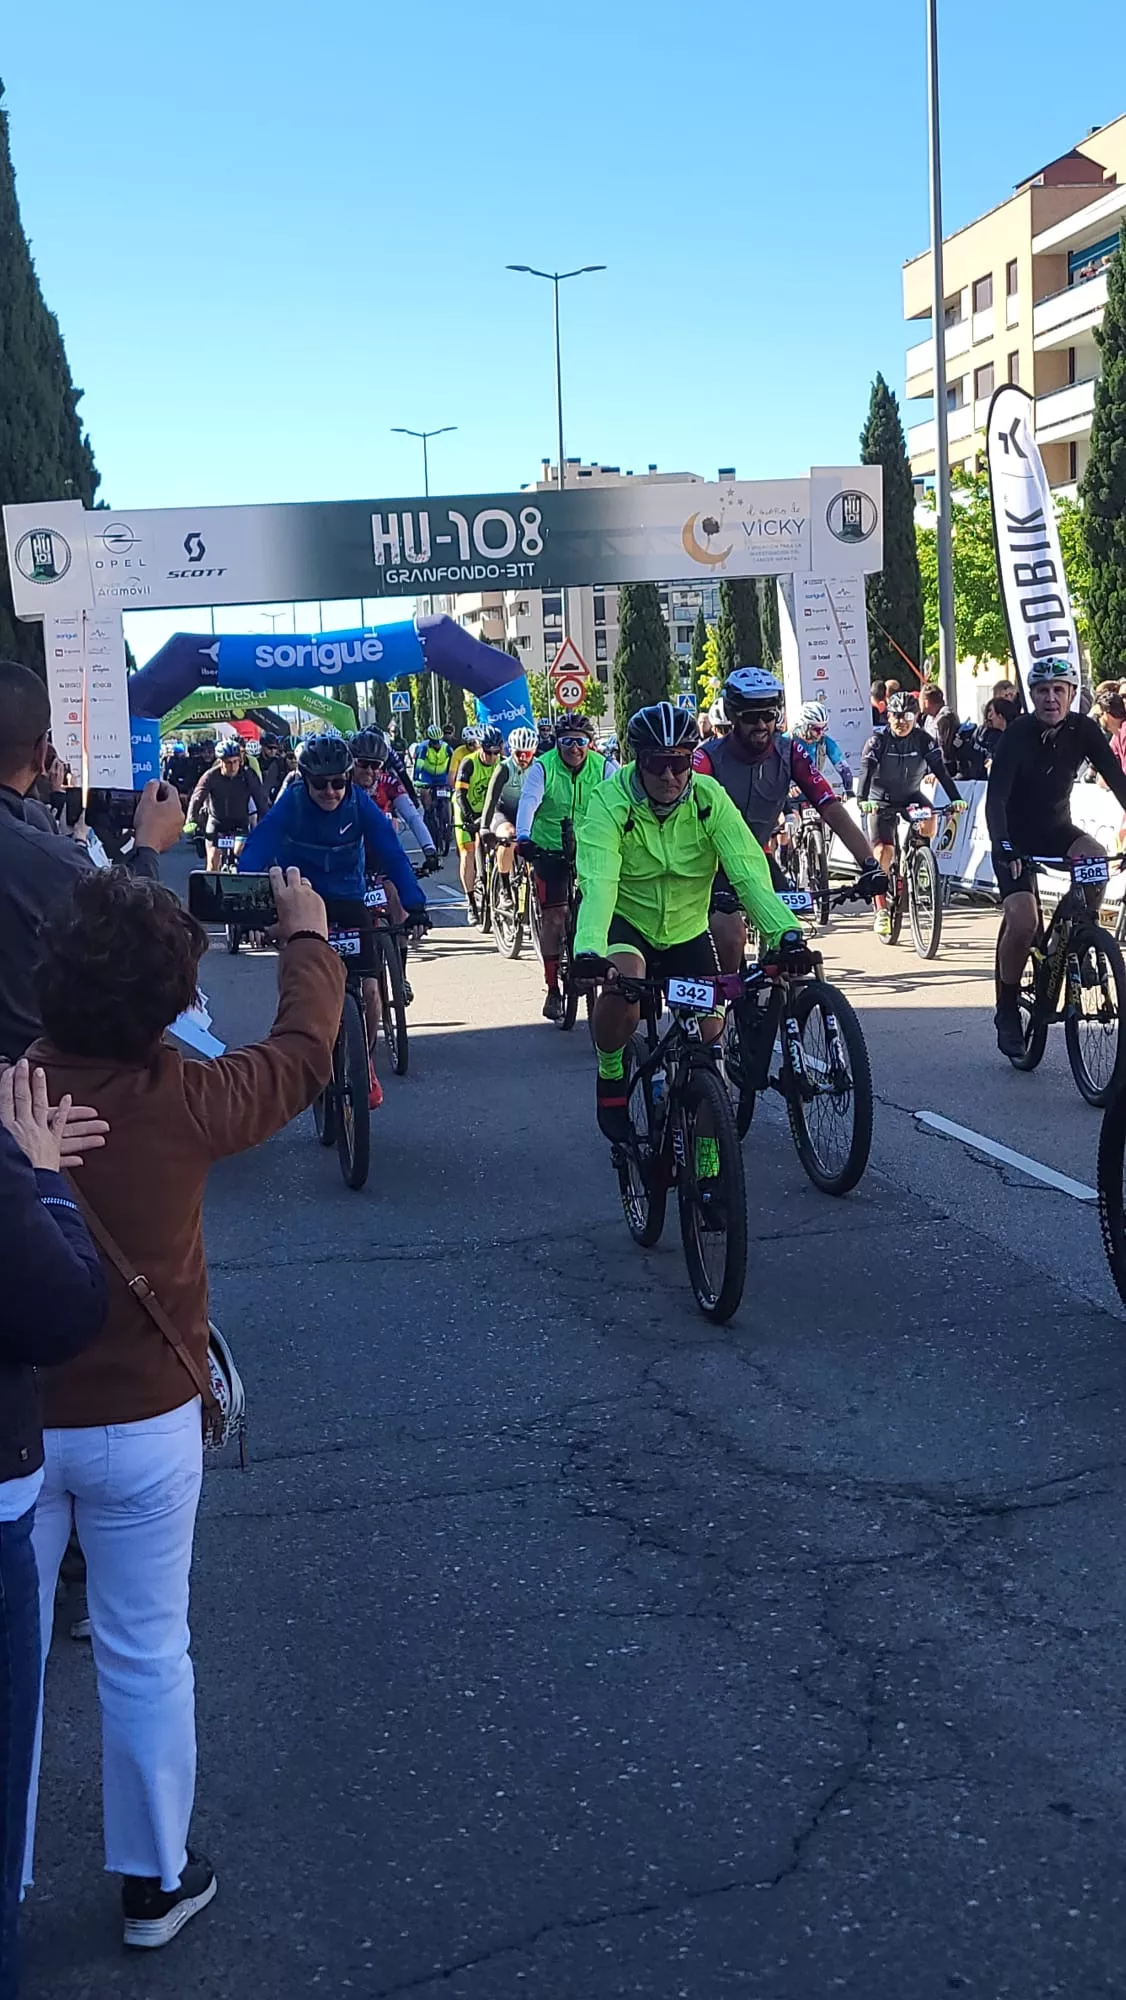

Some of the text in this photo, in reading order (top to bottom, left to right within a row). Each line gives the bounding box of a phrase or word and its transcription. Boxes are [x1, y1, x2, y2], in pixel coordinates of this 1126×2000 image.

[371, 506, 544, 566] HU-108
[95, 559, 147, 569] OPEL
[166, 568, 228, 579] SCOTT
[1004, 507, 1074, 659] GOBIK
[561, 686, 580, 698] 20
[781, 894, 807, 905] 559
[676, 984, 707, 1002] 342
